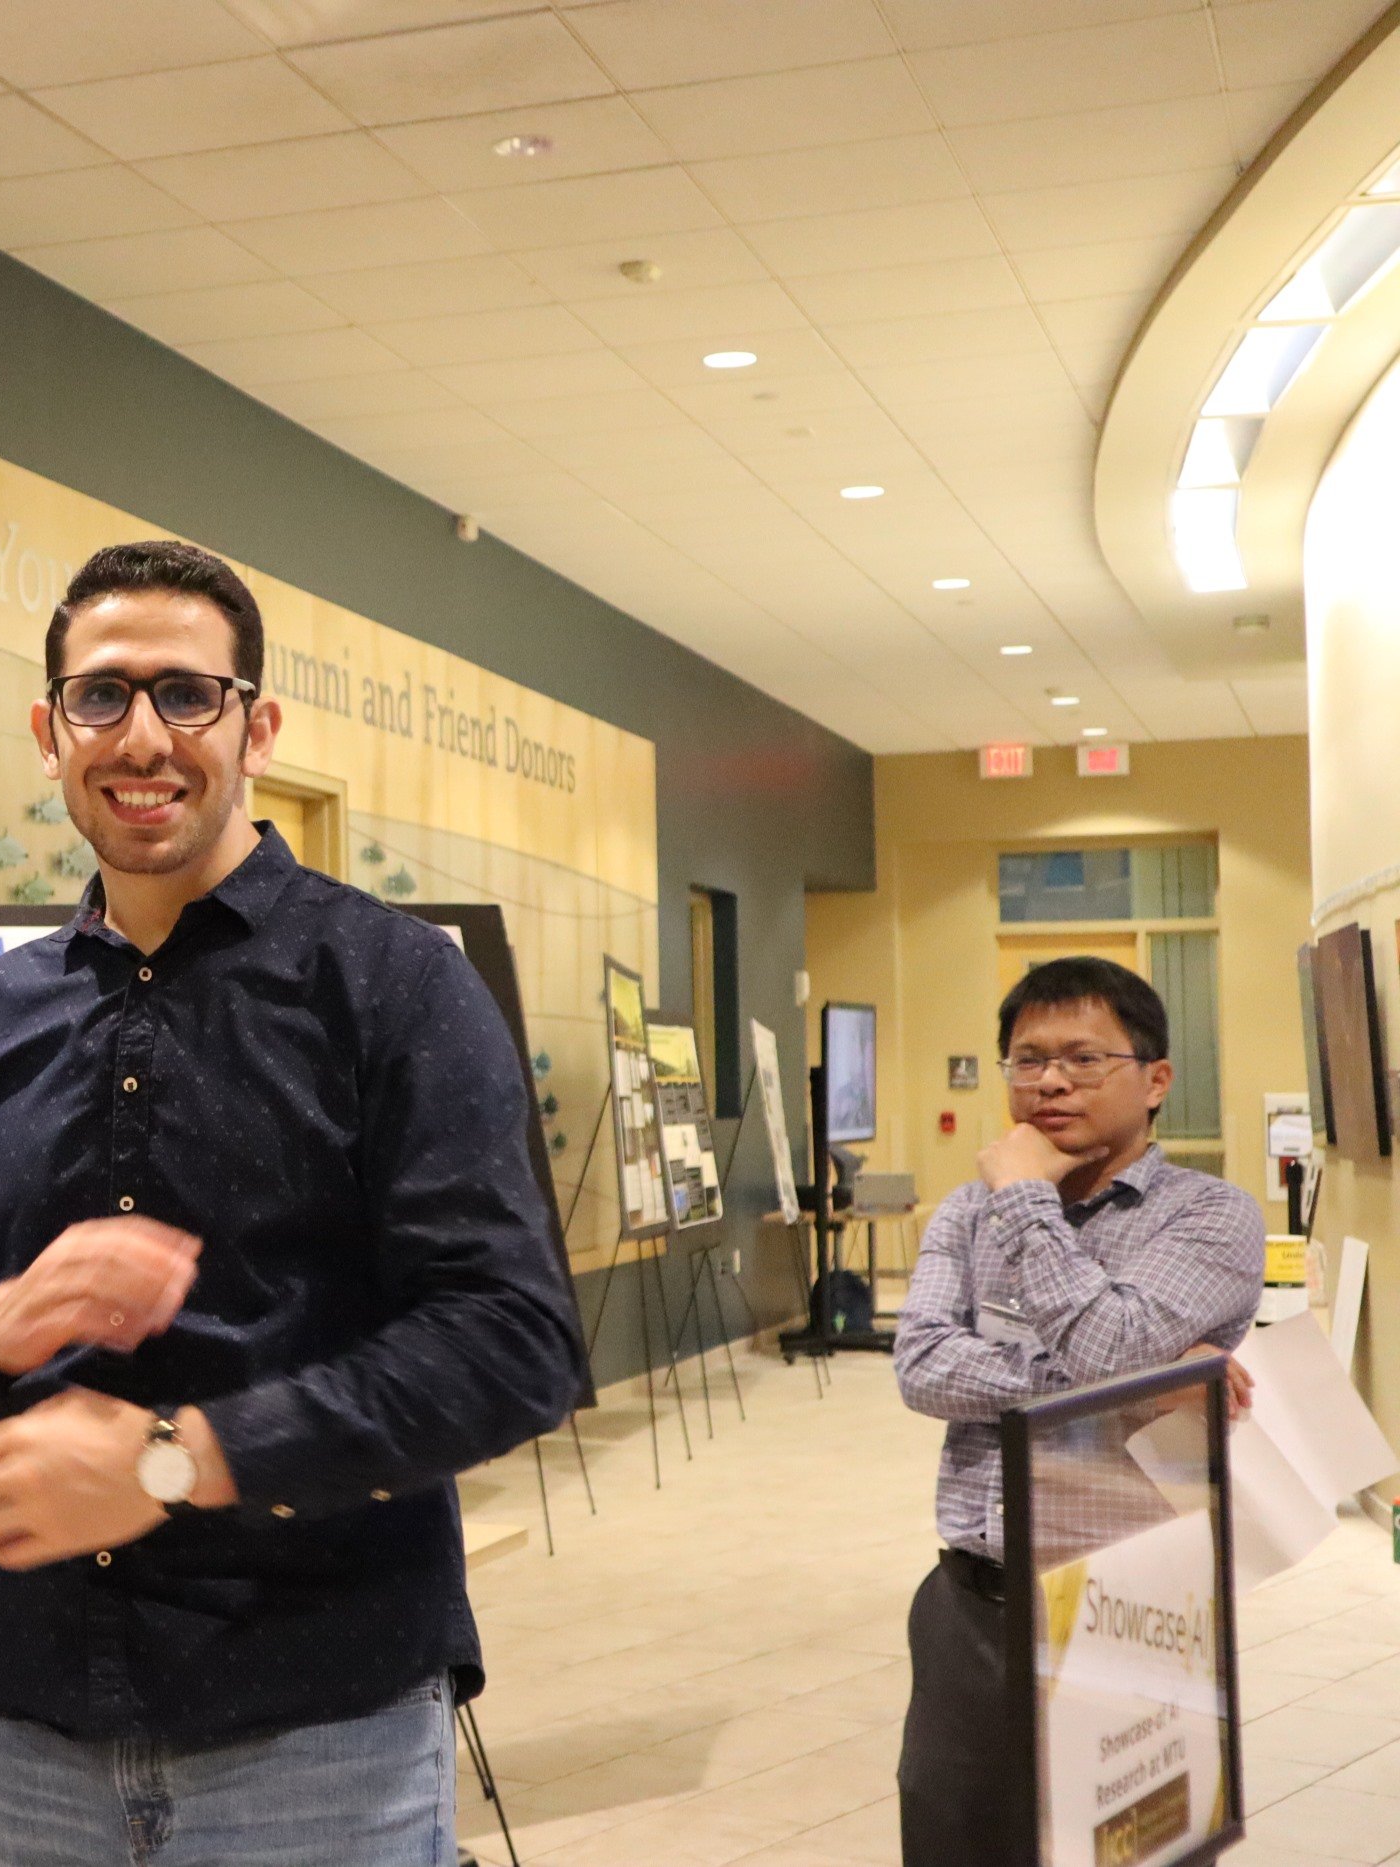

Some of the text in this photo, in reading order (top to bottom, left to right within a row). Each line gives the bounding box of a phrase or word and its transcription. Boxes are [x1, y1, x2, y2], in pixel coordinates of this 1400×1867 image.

[267, 640, 352, 718] umni
[362, 671, 413, 738] and
[422, 684, 498, 769] Friend
[504, 717, 576, 794] Donors
[1086, 1577, 1187, 1654] Showcase
[1099, 1716, 1153, 1763] Showcase
[1096, 1762, 1147, 1809] Research
